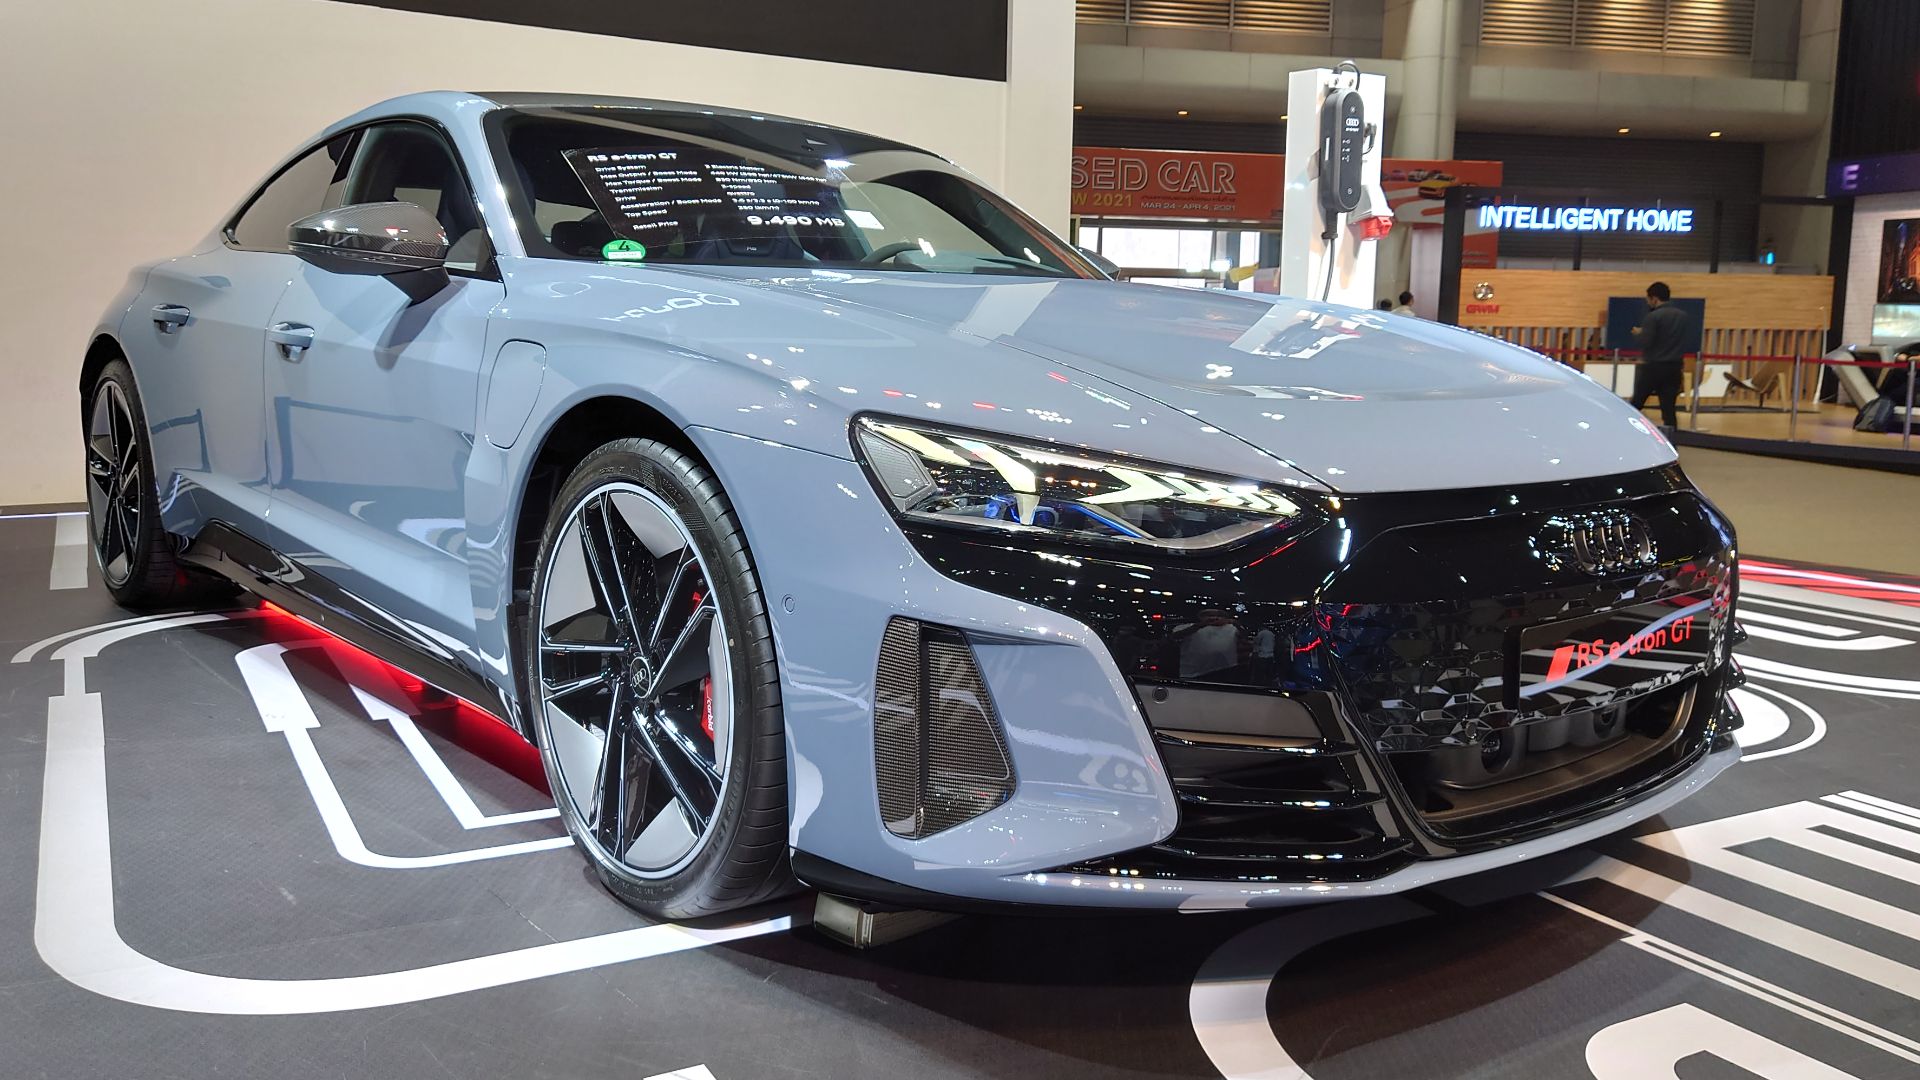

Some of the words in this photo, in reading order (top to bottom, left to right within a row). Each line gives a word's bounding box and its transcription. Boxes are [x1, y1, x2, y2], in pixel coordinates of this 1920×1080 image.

[587, 154, 608, 162] RS
[611, 153, 656, 161] e-tron
[658, 152, 677, 160] GT
[1157, 160, 1236, 193] CAR
[609, 186, 663, 194] Transmission
[1093, 194, 1133, 207] 2021
[746, 215, 813, 225] 9.490
[815, 217, 845, 227] MB
[1480, 205, 1624, 231] INTELLIGENT
[1626, 209, 1693, 232] HOME
[618, 240, 631, 252] 4
[1577, 639, 1604, 669] RS
[1609, 629, 1667, 660] e-tron
[1671, 615, 1695, 643] GT
